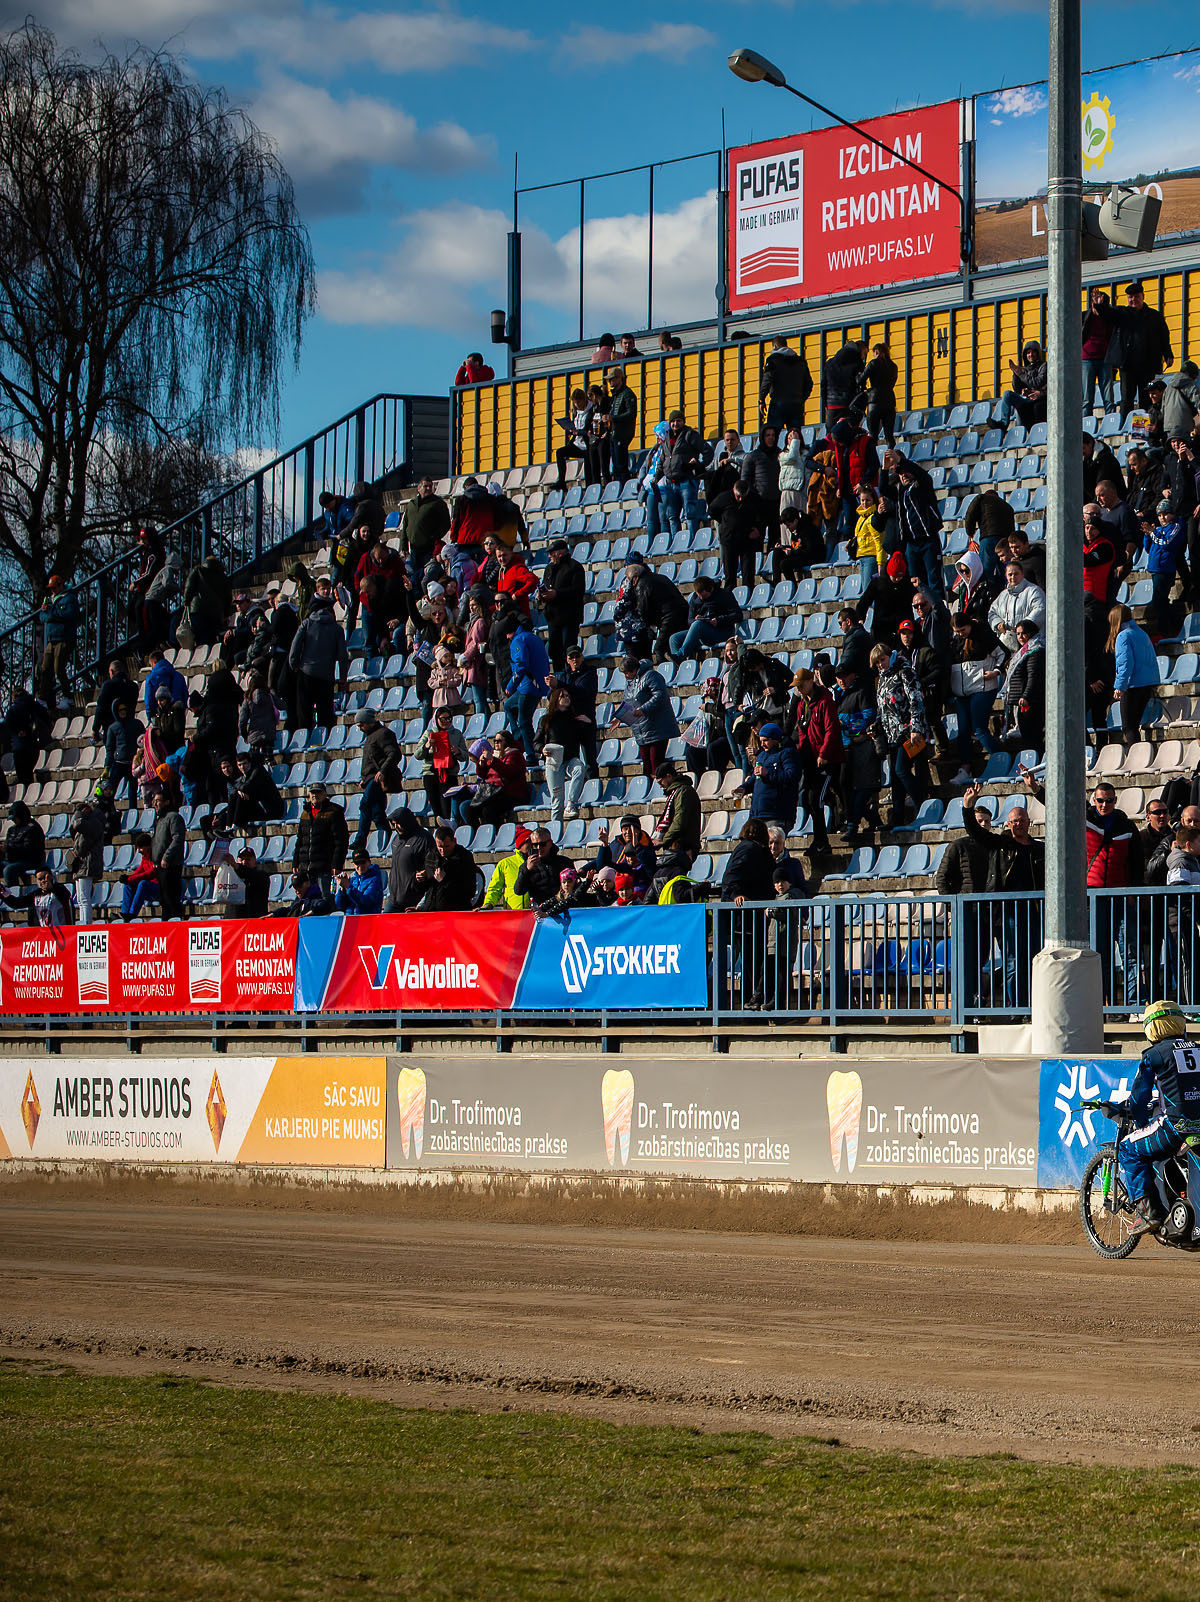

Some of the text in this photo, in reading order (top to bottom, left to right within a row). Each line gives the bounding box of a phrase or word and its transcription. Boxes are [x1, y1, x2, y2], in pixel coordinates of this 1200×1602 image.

[839, 132, 922, 180] IZCILAM
[740, 157, 800, 202] PUFAS
[739, 206, 800, 232] MADE IN GERMANY
[822, 181, 940, 233] REMONTAM
[827, 233, 934, 272] WWW.PUFAS.LV
[21, 940, 57, 959] IZCILAM
[78, 935, 107, 954] PUFAS
[129, 936, 167, 955] IZCILAM
[190, 931, 220, 950] PUFAS
[244, 933, 285, 952] IZCILAM
[13, 963, 64, 982] REMONTAM
[121, 961, 175, 980] REMONTAM
[235, 958, 294, 977] REMONTAM
[591, 944, 680, 976] STOKKER
[395, 957, 478, 990] Valvoline
[122, 983, 175, 997] WWW.PUFAS.LV
[236, 982, 294, 996] WWW.PUFAS.LV
[1183, 1050, 1197, 1071] 5
[53, 1077, 193, 1119] AMBER STUDIOS
[324, 1081, 380, 1107] SĀC SAVU
[430, 1099, 522, 1126] Dr. Trofimova
[638, 1102, 740, 1131] Dr. Trofimova
[866, 1105, 979, 1135] Dr. Trofimova
[66, 1129, 183, 1149] WWW.AMBER-STUDIOS.COM
[265, 1117, 383, 1140] KARJERU PIE MUMS!
[430, 1130, 568, 1159] zobārstniecības prakse
[637, 1135, 790, 1165] zobārstniecības prakse
[866, 1141, 1035, 1170] zobārstniecības prakse
